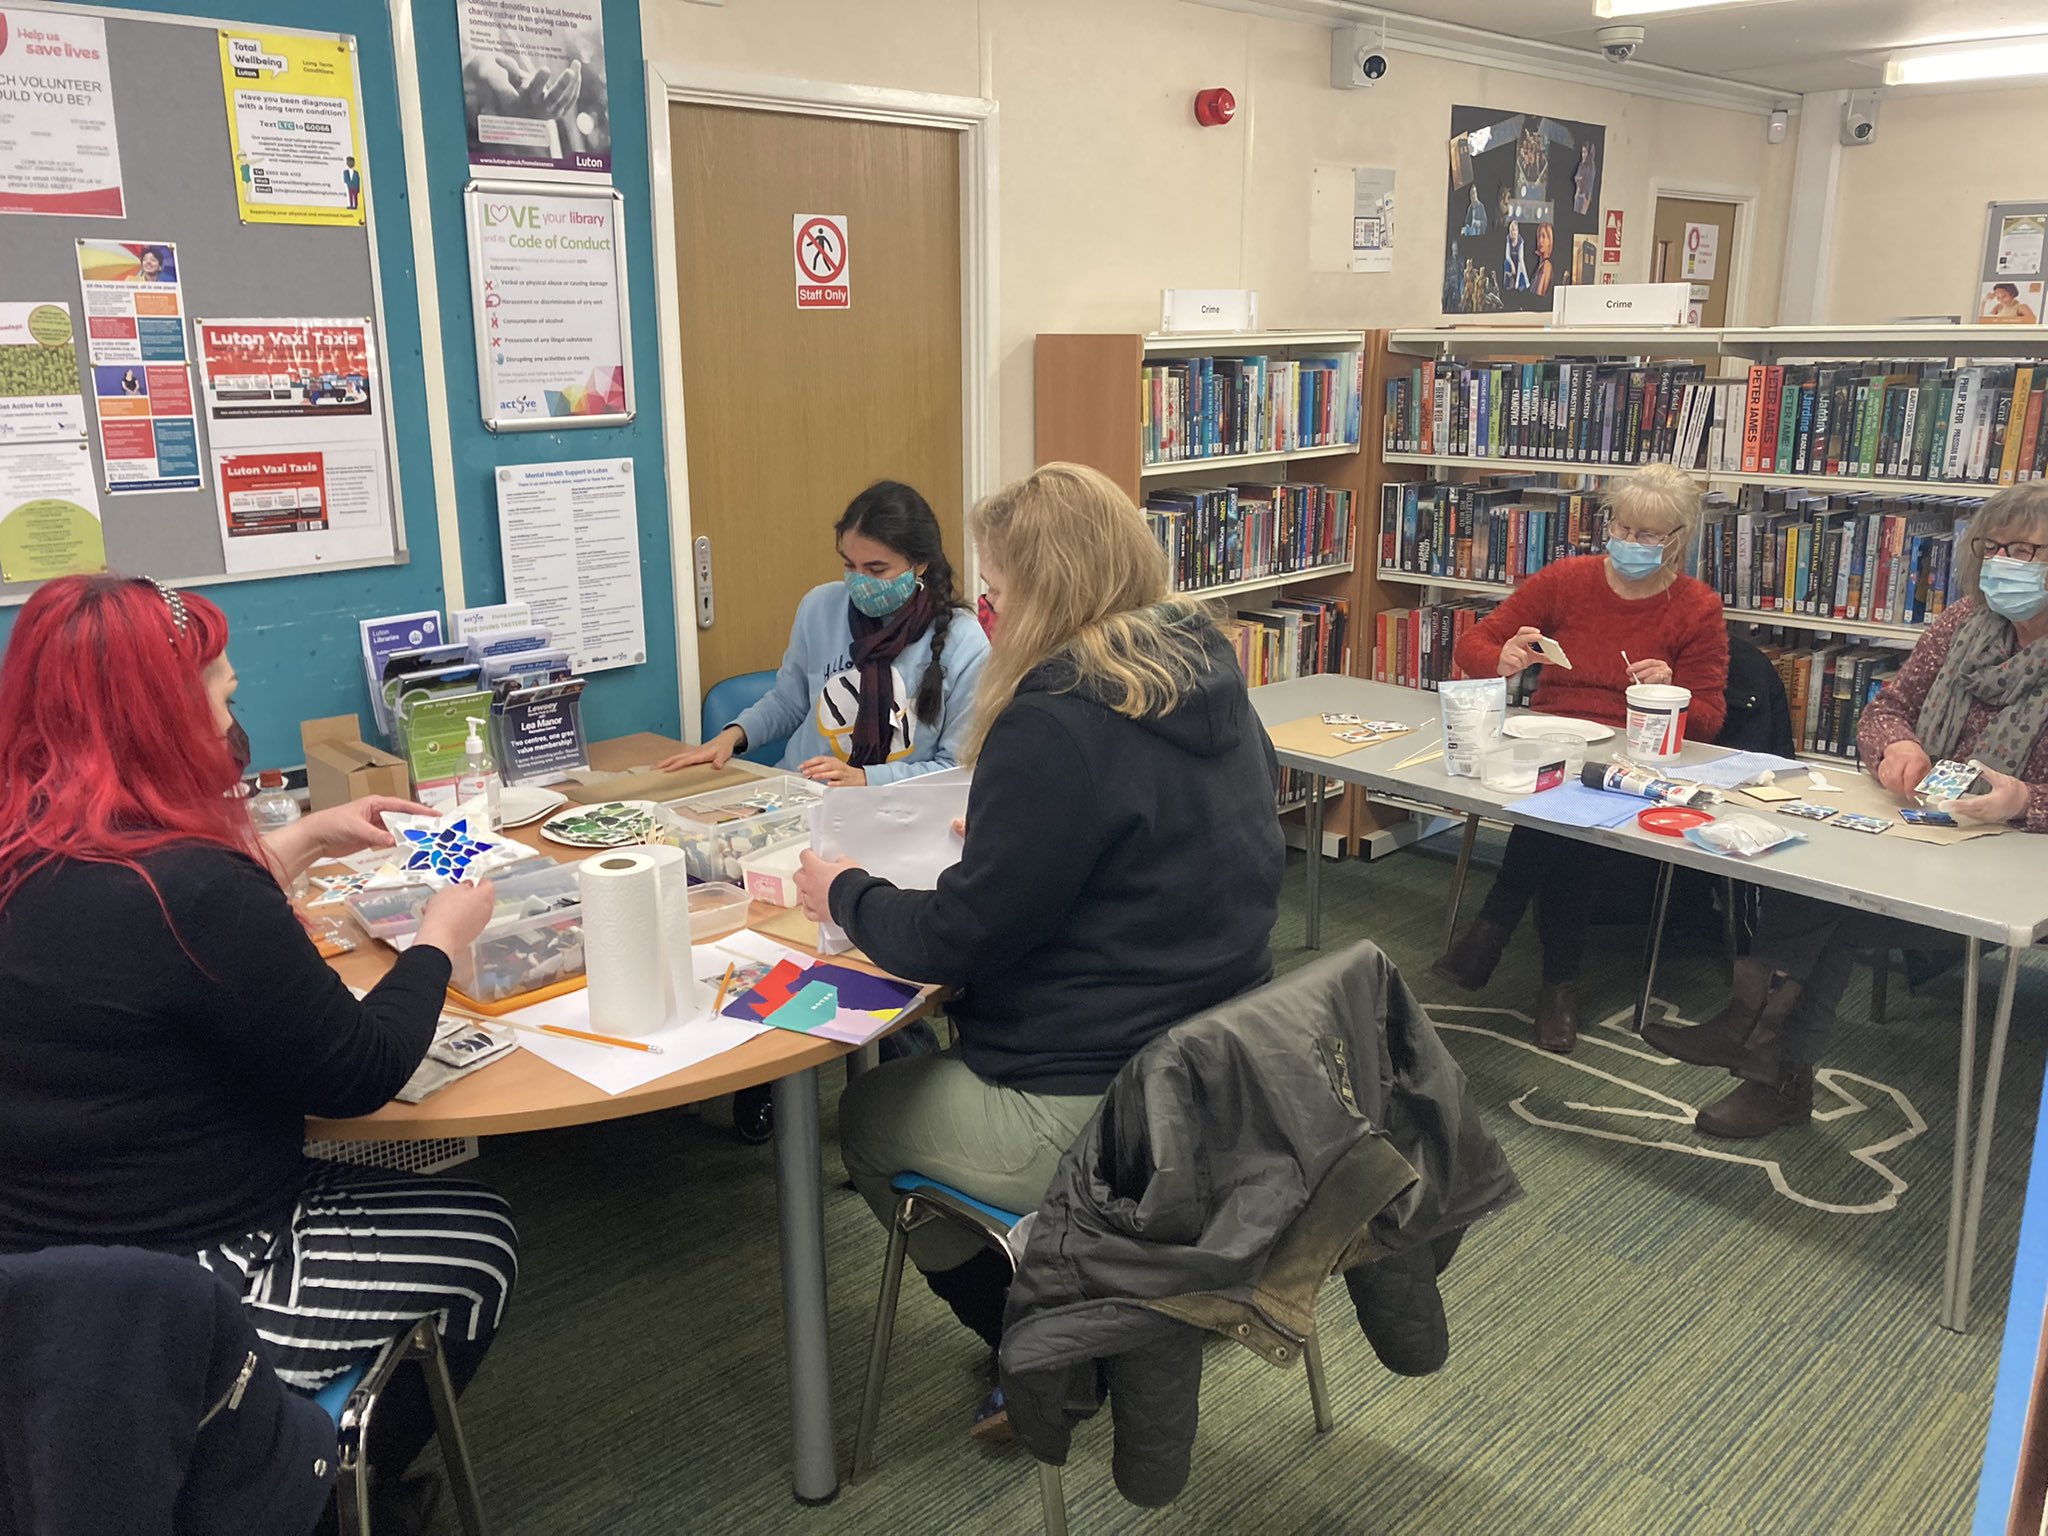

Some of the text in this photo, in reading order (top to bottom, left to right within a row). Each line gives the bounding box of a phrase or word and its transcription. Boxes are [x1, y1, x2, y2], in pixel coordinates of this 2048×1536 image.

[468, 7, 493, 18] charity
[518, 13, 533, 22] than
[534, 16, 554, 26] giving
[555, 19, 569, 27] cash
[500, 1, 530, 13] donating
[545, 7, 561, 16] local
[562, 10, 592, 20] homeless
[17, 27, 60, 42] Help us
[469, 18, 501, 28] someone
[525, 25, 552, 36] begging
[26, 43, 100, 60] save lives
[233, 42, 257, 52] Total
[234, 55, 282, 68] Wellbeing
[237, 69, 257, 77] Luton
[303, 67, 334, 75] Conditions
[19, 76, 102, 92] VOLUNTEER
[33, 91, 92, 106] YOU BE?
[241, 93, 261, 101] Have
[280, 97, 300, 105] been
[301, 99, 342, 108] diagnosed
[265, 104, 282, 113] long
[306, 108, 346, 117] condition?
[260, 120, 303, 130] Text LTC to
[576, 156, 603, 168] Luton
[542, 212, 566, 224] your
[569, 211, 604, 227] library
[508, 234, 610, 250] Code of Conduct
[800, 289, 846, 302] Staff Only
[1201, 305, 1220, 313] Crime
[1606, 300, 1632, 309] Crime
[210, 330, 358, 346] Luton Vaxi Taxis
[12, 401, 33, 409] Active
[46, 400, 62, 408] Less
[1510, 389, 1519, 426] EVANOVICH
[1522, 389, 1530, 425] EVANOVICH
[1530, 385, 1539, 421] EVANOVICH
[1748, 370, 1763, 442] PETER JAMES
[1764, 369, 1779, 443] PETER JAMES
[1998, 397, 2012, 421] Kent
[1782, 388, 1795, 448] PETER JAMES
[1800, 394, 1814, 432] Jardine
[1905, 390, 1917, 437] EARTH STORM
[1948, 378, 1969, 467] PHILIP KERR PRUSSIAN BLUE
[227, 462, 317, 477] Luton Vaxi Taxis
[564, 469, 586, 477] Support
[1465, 493, 1473, 535] DECEPTION ON
[1724, 531, 1733, 556] Leon
[1740, 532, 1748, 558] Leon
[374, 634, 399, 643] Libraries
[1441, 615, 1450, 646] Griffiths
[521, 717, 562, 730] Lea Manor
[524, 736, 548, 745] centres,
[534, 738, 572, 751] membership!
